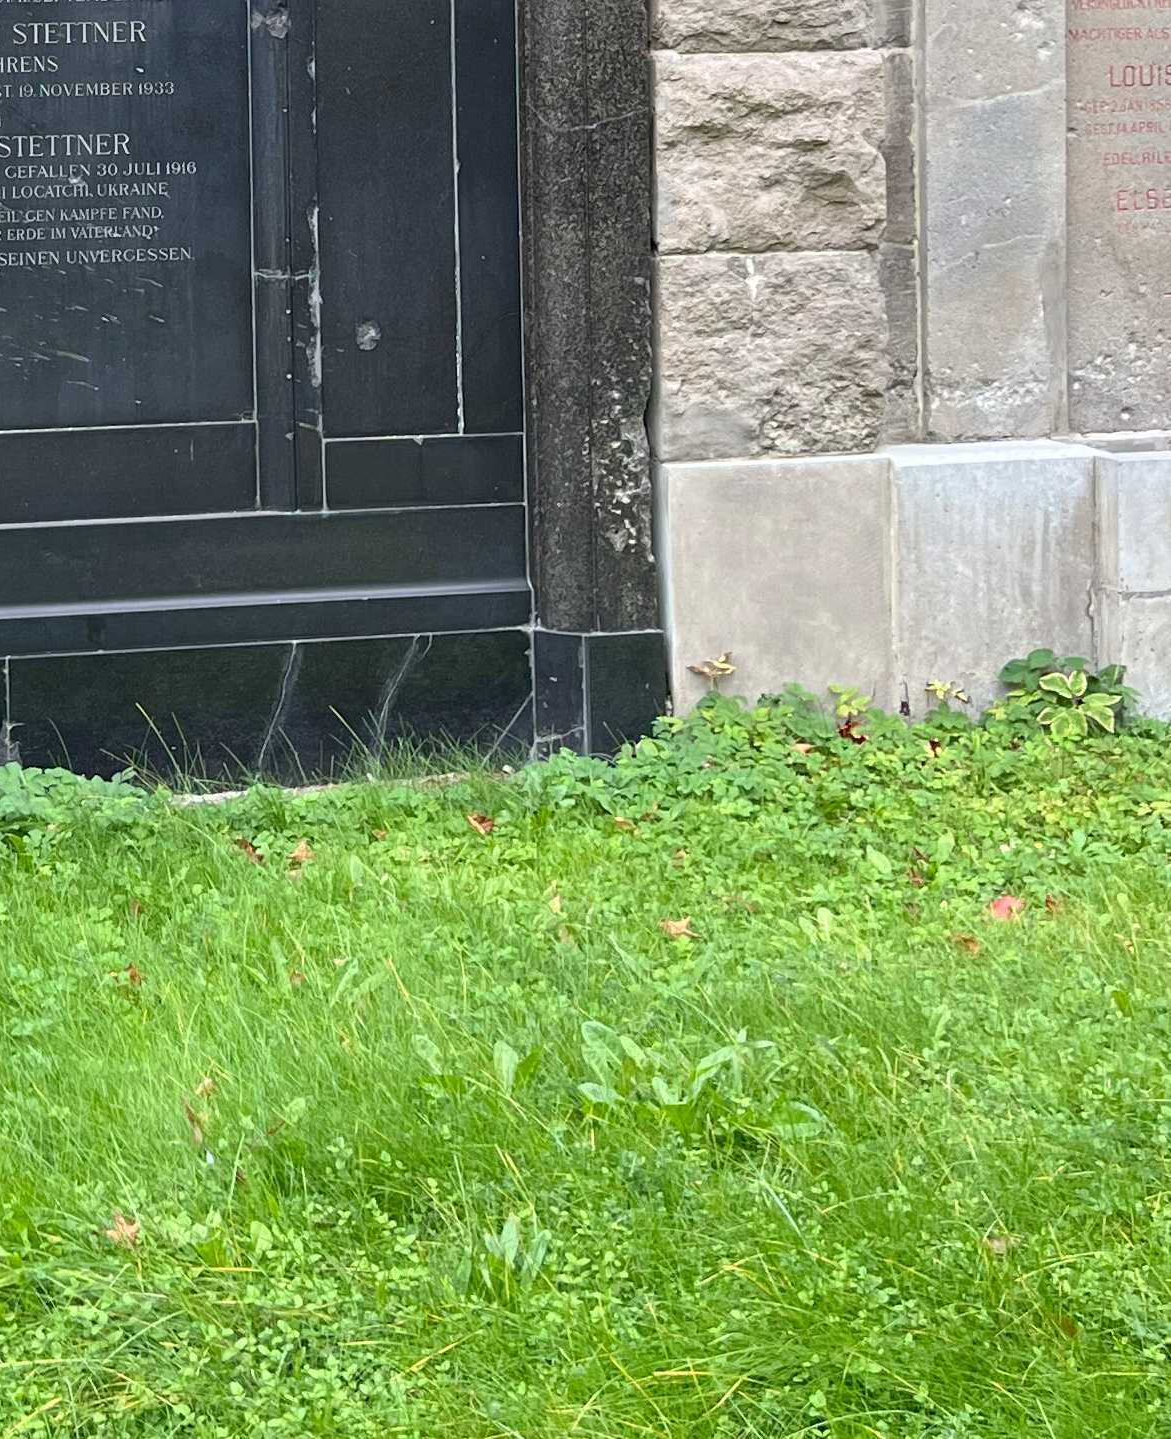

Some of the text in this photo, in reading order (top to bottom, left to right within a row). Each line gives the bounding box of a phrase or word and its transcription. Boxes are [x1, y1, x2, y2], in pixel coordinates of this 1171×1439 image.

[12, 21, 147, 45] STETTNER
[39, 82, 134, 98] NOVEMBER
[138, 81, 175, 96] 1933
[5, 162, 91, 179] GEFALLEN
[96, 162, 118, 176] 30
[122, 162, 161, 176] JULI
[166, 161, 197, 175] 1916
[60, 208, 118, 221] KAMPFE
[7, 227, 46, 241] ERDE
[51, 226, 67, 240] IM
